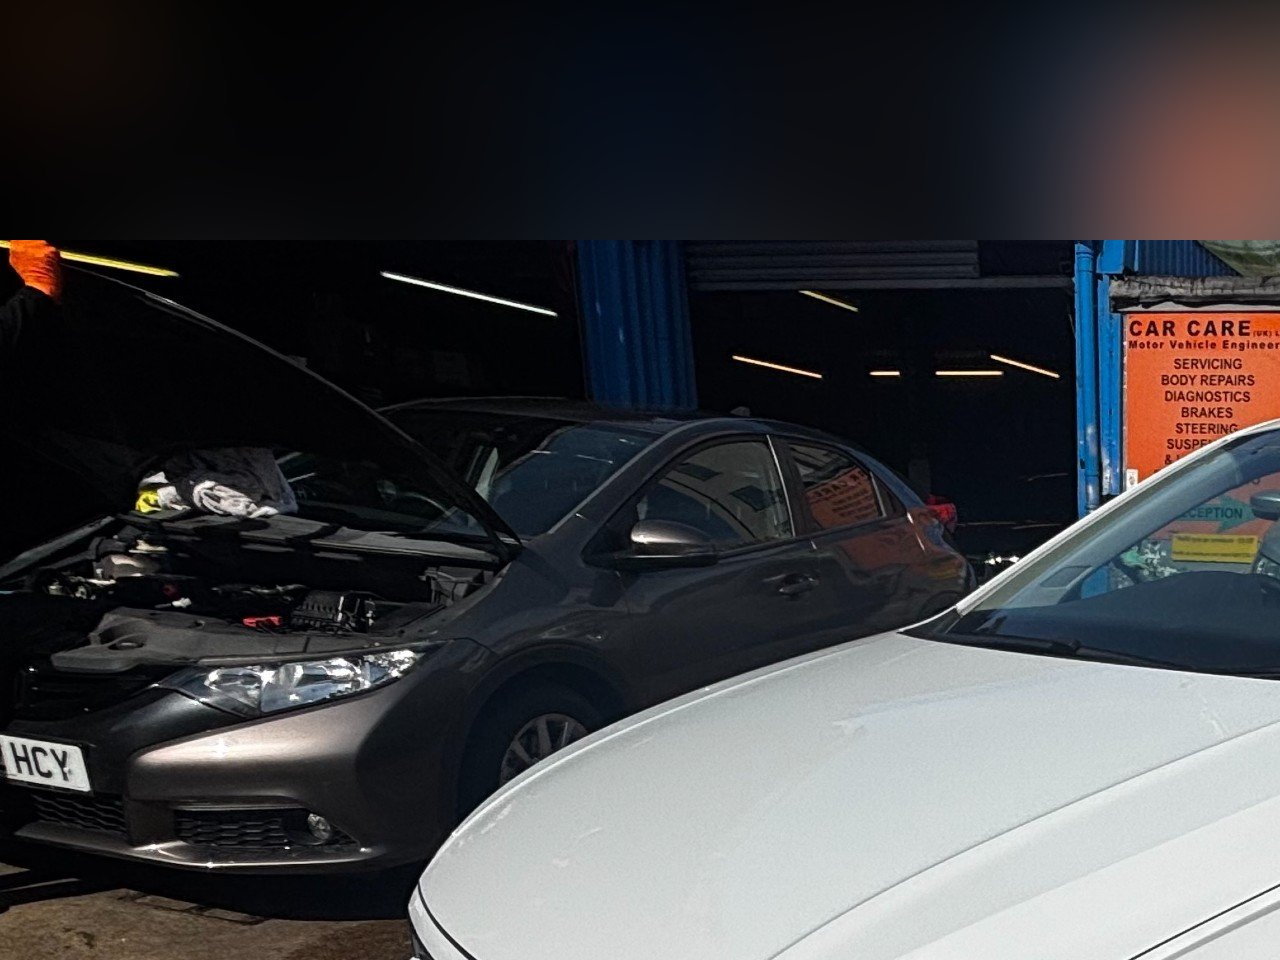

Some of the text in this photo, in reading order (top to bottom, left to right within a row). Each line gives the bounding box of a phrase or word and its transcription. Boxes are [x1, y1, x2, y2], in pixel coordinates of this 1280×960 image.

[1129, 320, 1175, 337] CAR
[1187, 320, 1250, 337] CARE
[1128, 340, 1164, 350] Motor
[1169, 340, 1217, 350] Vehicle
[1174, 358, 1242, 370] SERVICING
[1161, 375, 1255, 386] BODY REPAIRS
[1164, 391, 1251, 402] DIAGNOSTICS
[1181, 407, 1233, 418] BRAKES
[1175, 423, 1238, 435] STEERING
[1167, 439, 1211, 450] SUSPE
[9, 741, 70, 782] HCY
